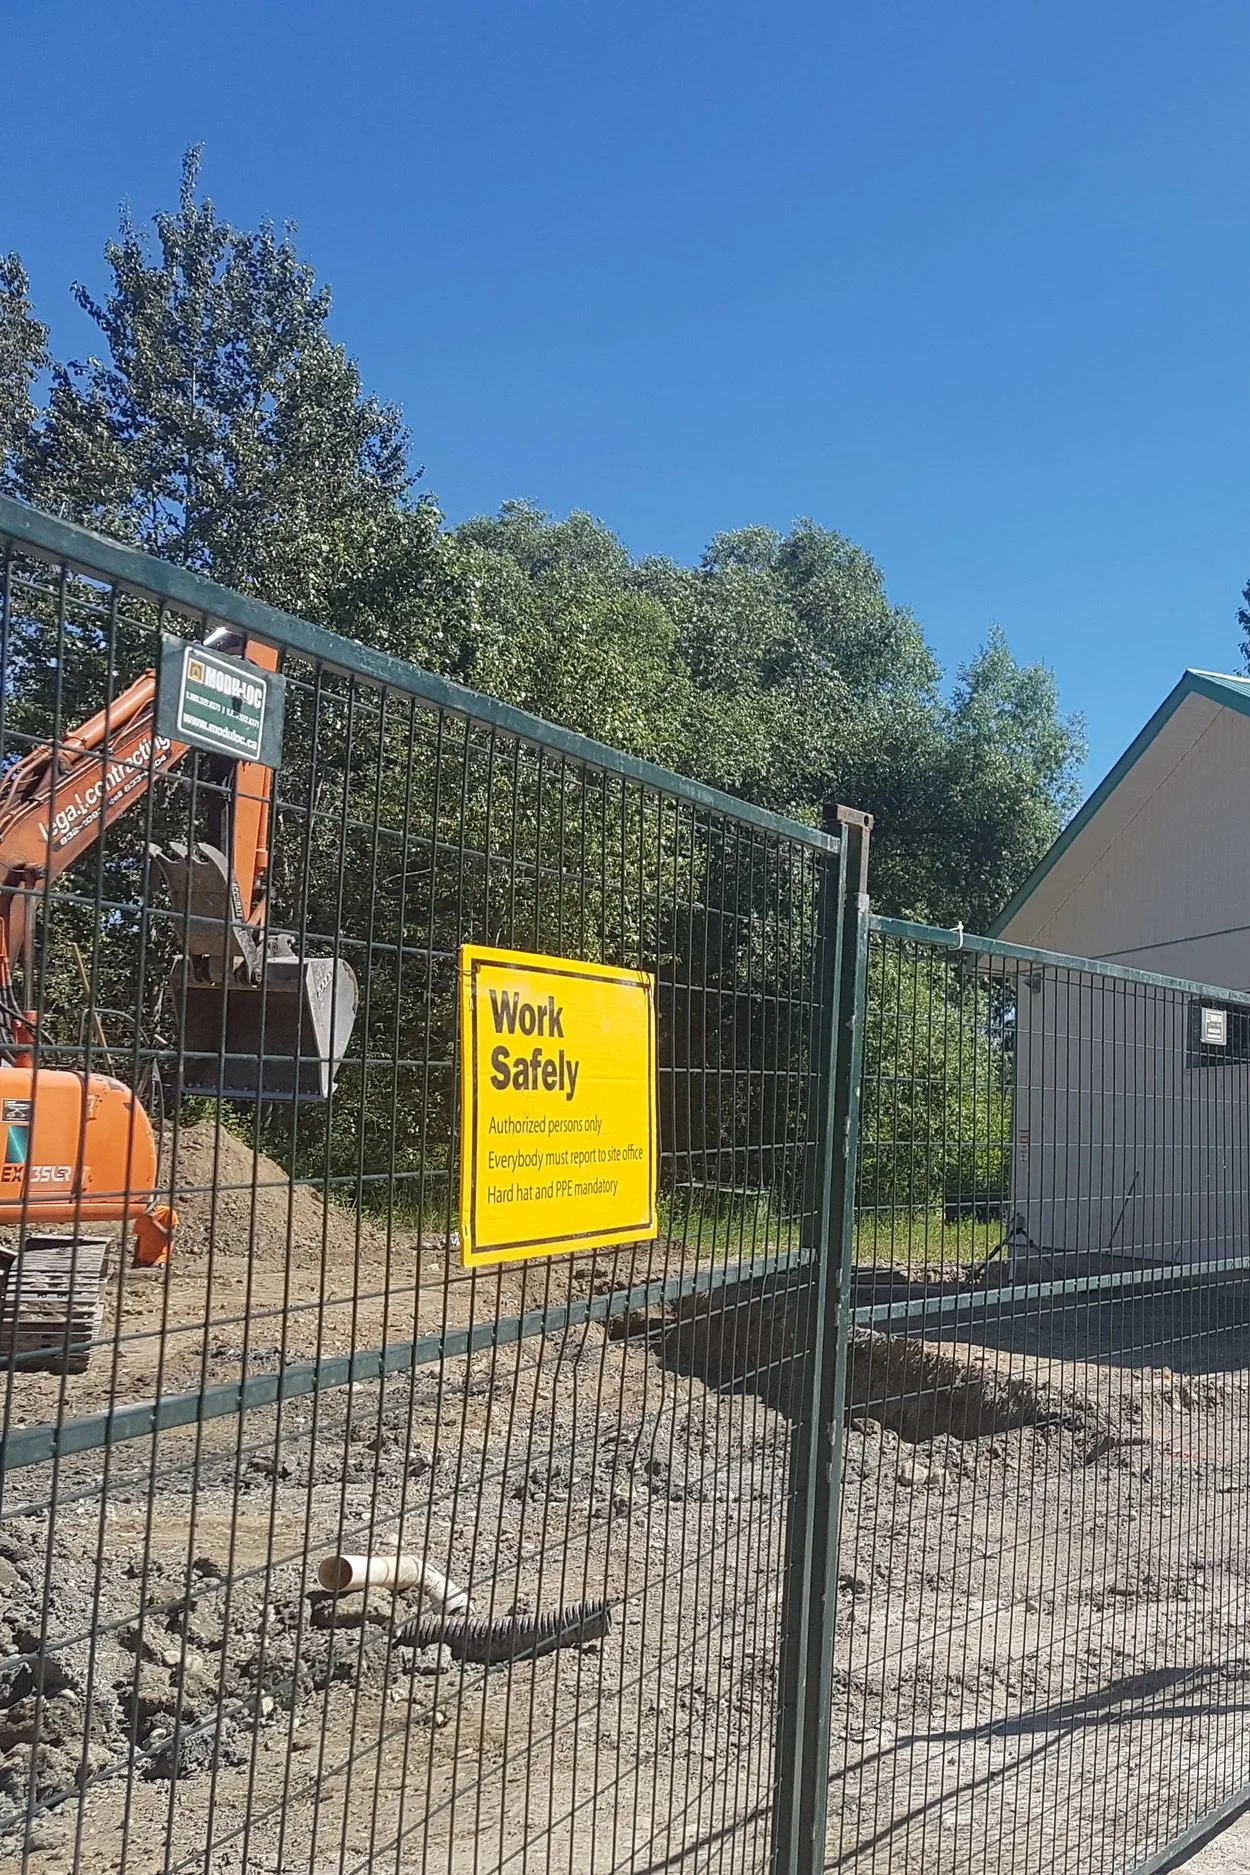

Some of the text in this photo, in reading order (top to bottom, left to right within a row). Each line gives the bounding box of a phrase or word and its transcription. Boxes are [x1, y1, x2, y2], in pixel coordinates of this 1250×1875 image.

[488, 988, 564, 1038] Work
[489, 1044, 579, 1102] Safely
[488, 1113, 603, 1138] Authorized persons only
[488, 1143, 644, 1173] Everybody must report to site office
[487, 1176, 619, 1205] Hard hat and PPE mandatory
